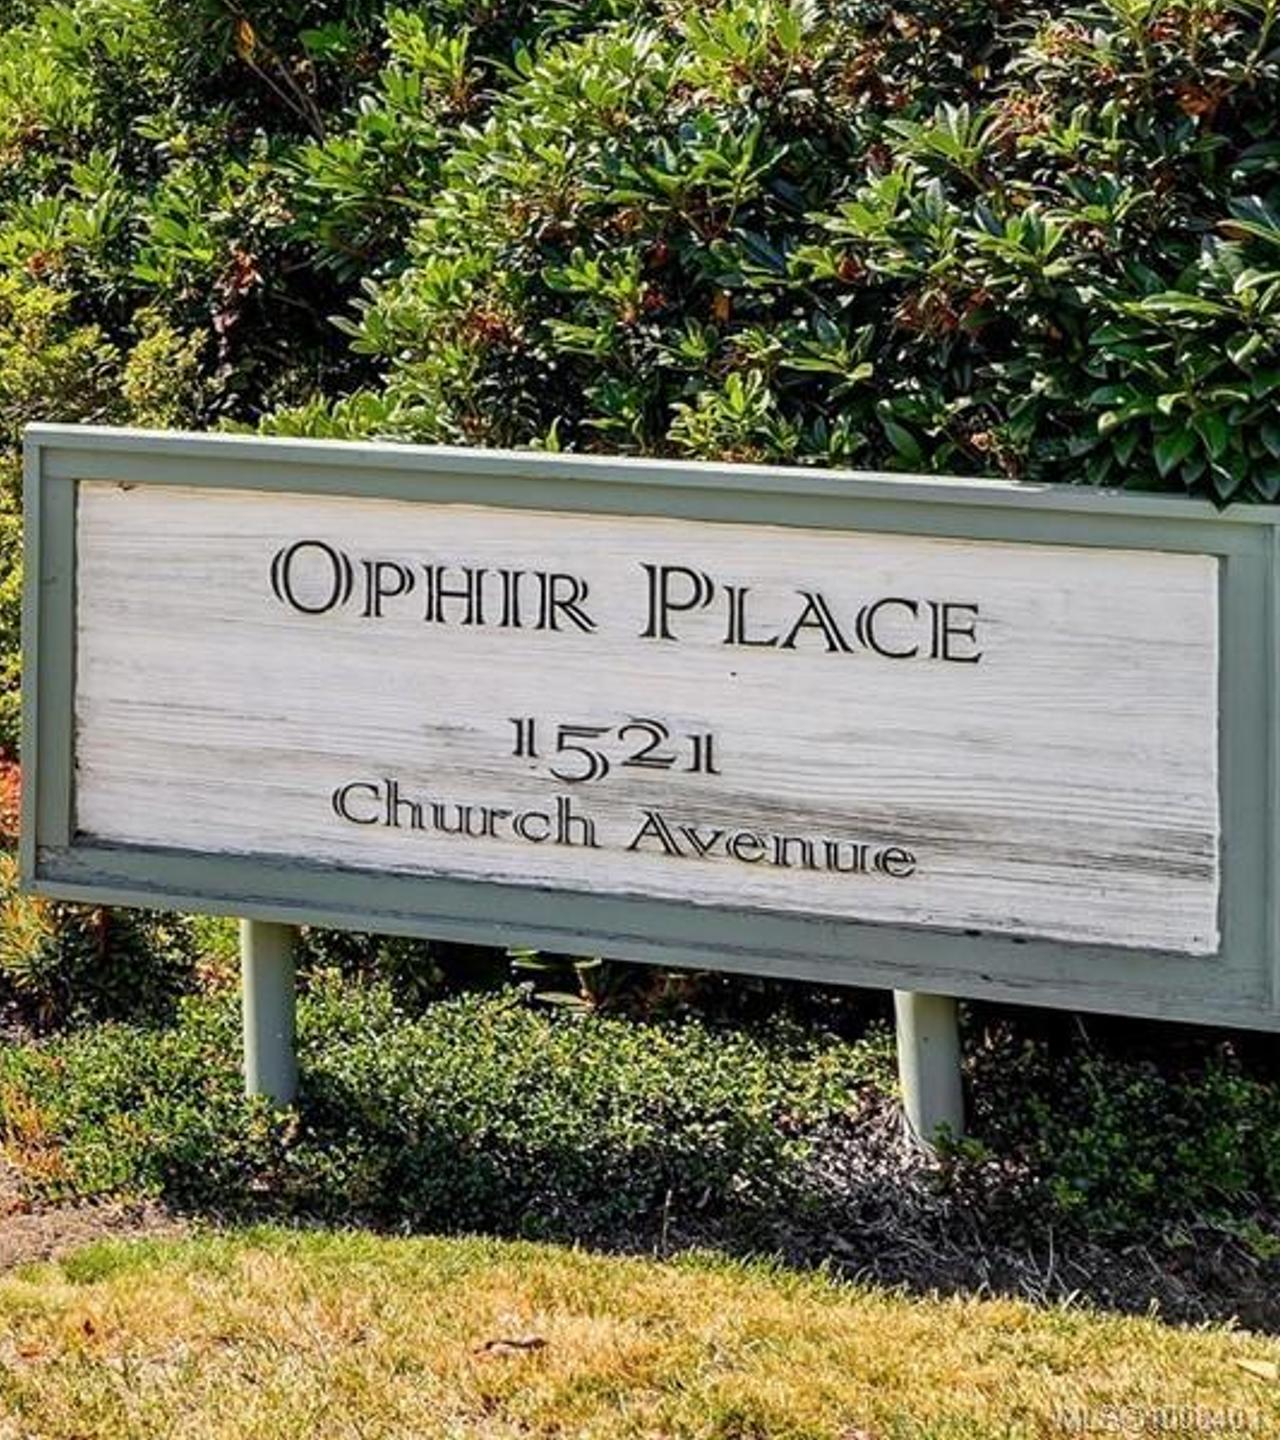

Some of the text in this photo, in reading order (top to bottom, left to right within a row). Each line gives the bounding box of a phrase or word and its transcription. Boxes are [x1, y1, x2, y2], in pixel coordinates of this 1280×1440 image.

[271, 539, 983, 663] OPHIR PLACE
[509, 716, 722, 783] 1521
[332, 778, 917, 878] Church Avenue
